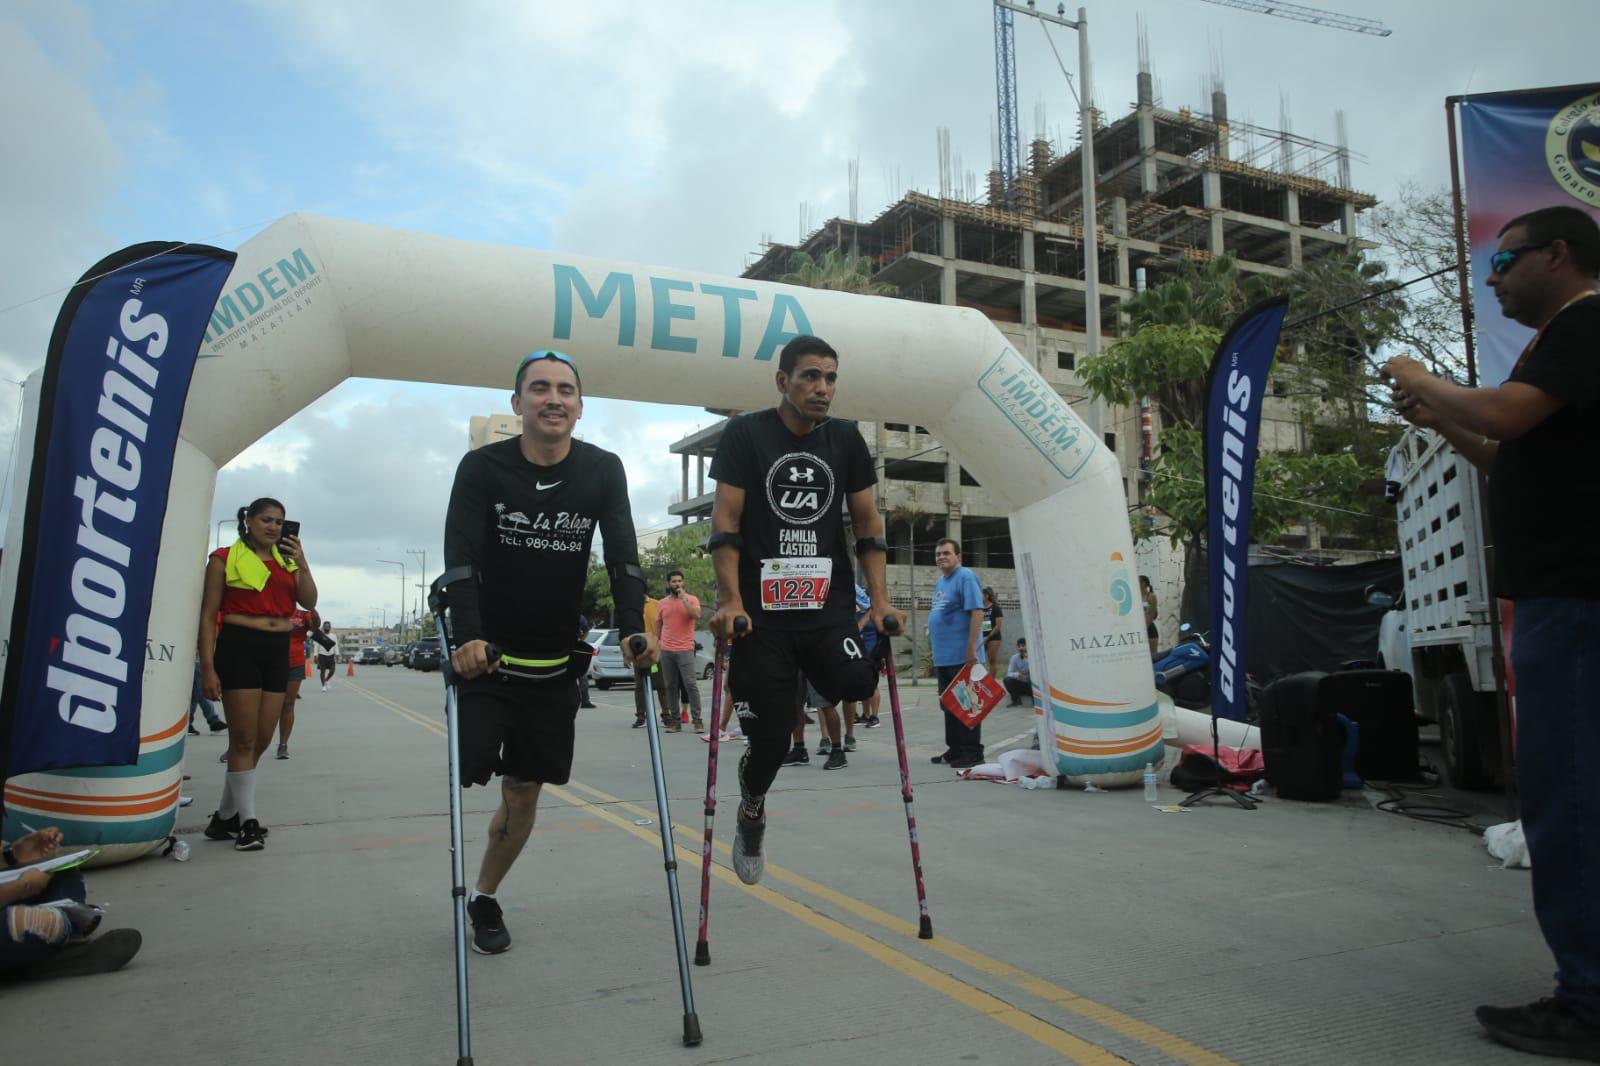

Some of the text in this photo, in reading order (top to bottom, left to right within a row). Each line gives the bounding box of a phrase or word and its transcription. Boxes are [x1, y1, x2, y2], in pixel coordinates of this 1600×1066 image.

[1554, 153, 1595, 199] Genaro
[552, 263, 815, 362] META
[1000, 373, 1078, 451] IMDEM
[1018, 367, 1081, 437] FUERZA
[780, 490, 818, 510] UA
[532, 511, 592, 535] La Palapa
[525, 537, 583, 552] 989-86-24
[779, 529, 818, 544] FAMILIA
[779, 543, 818, 556] CASTRO
